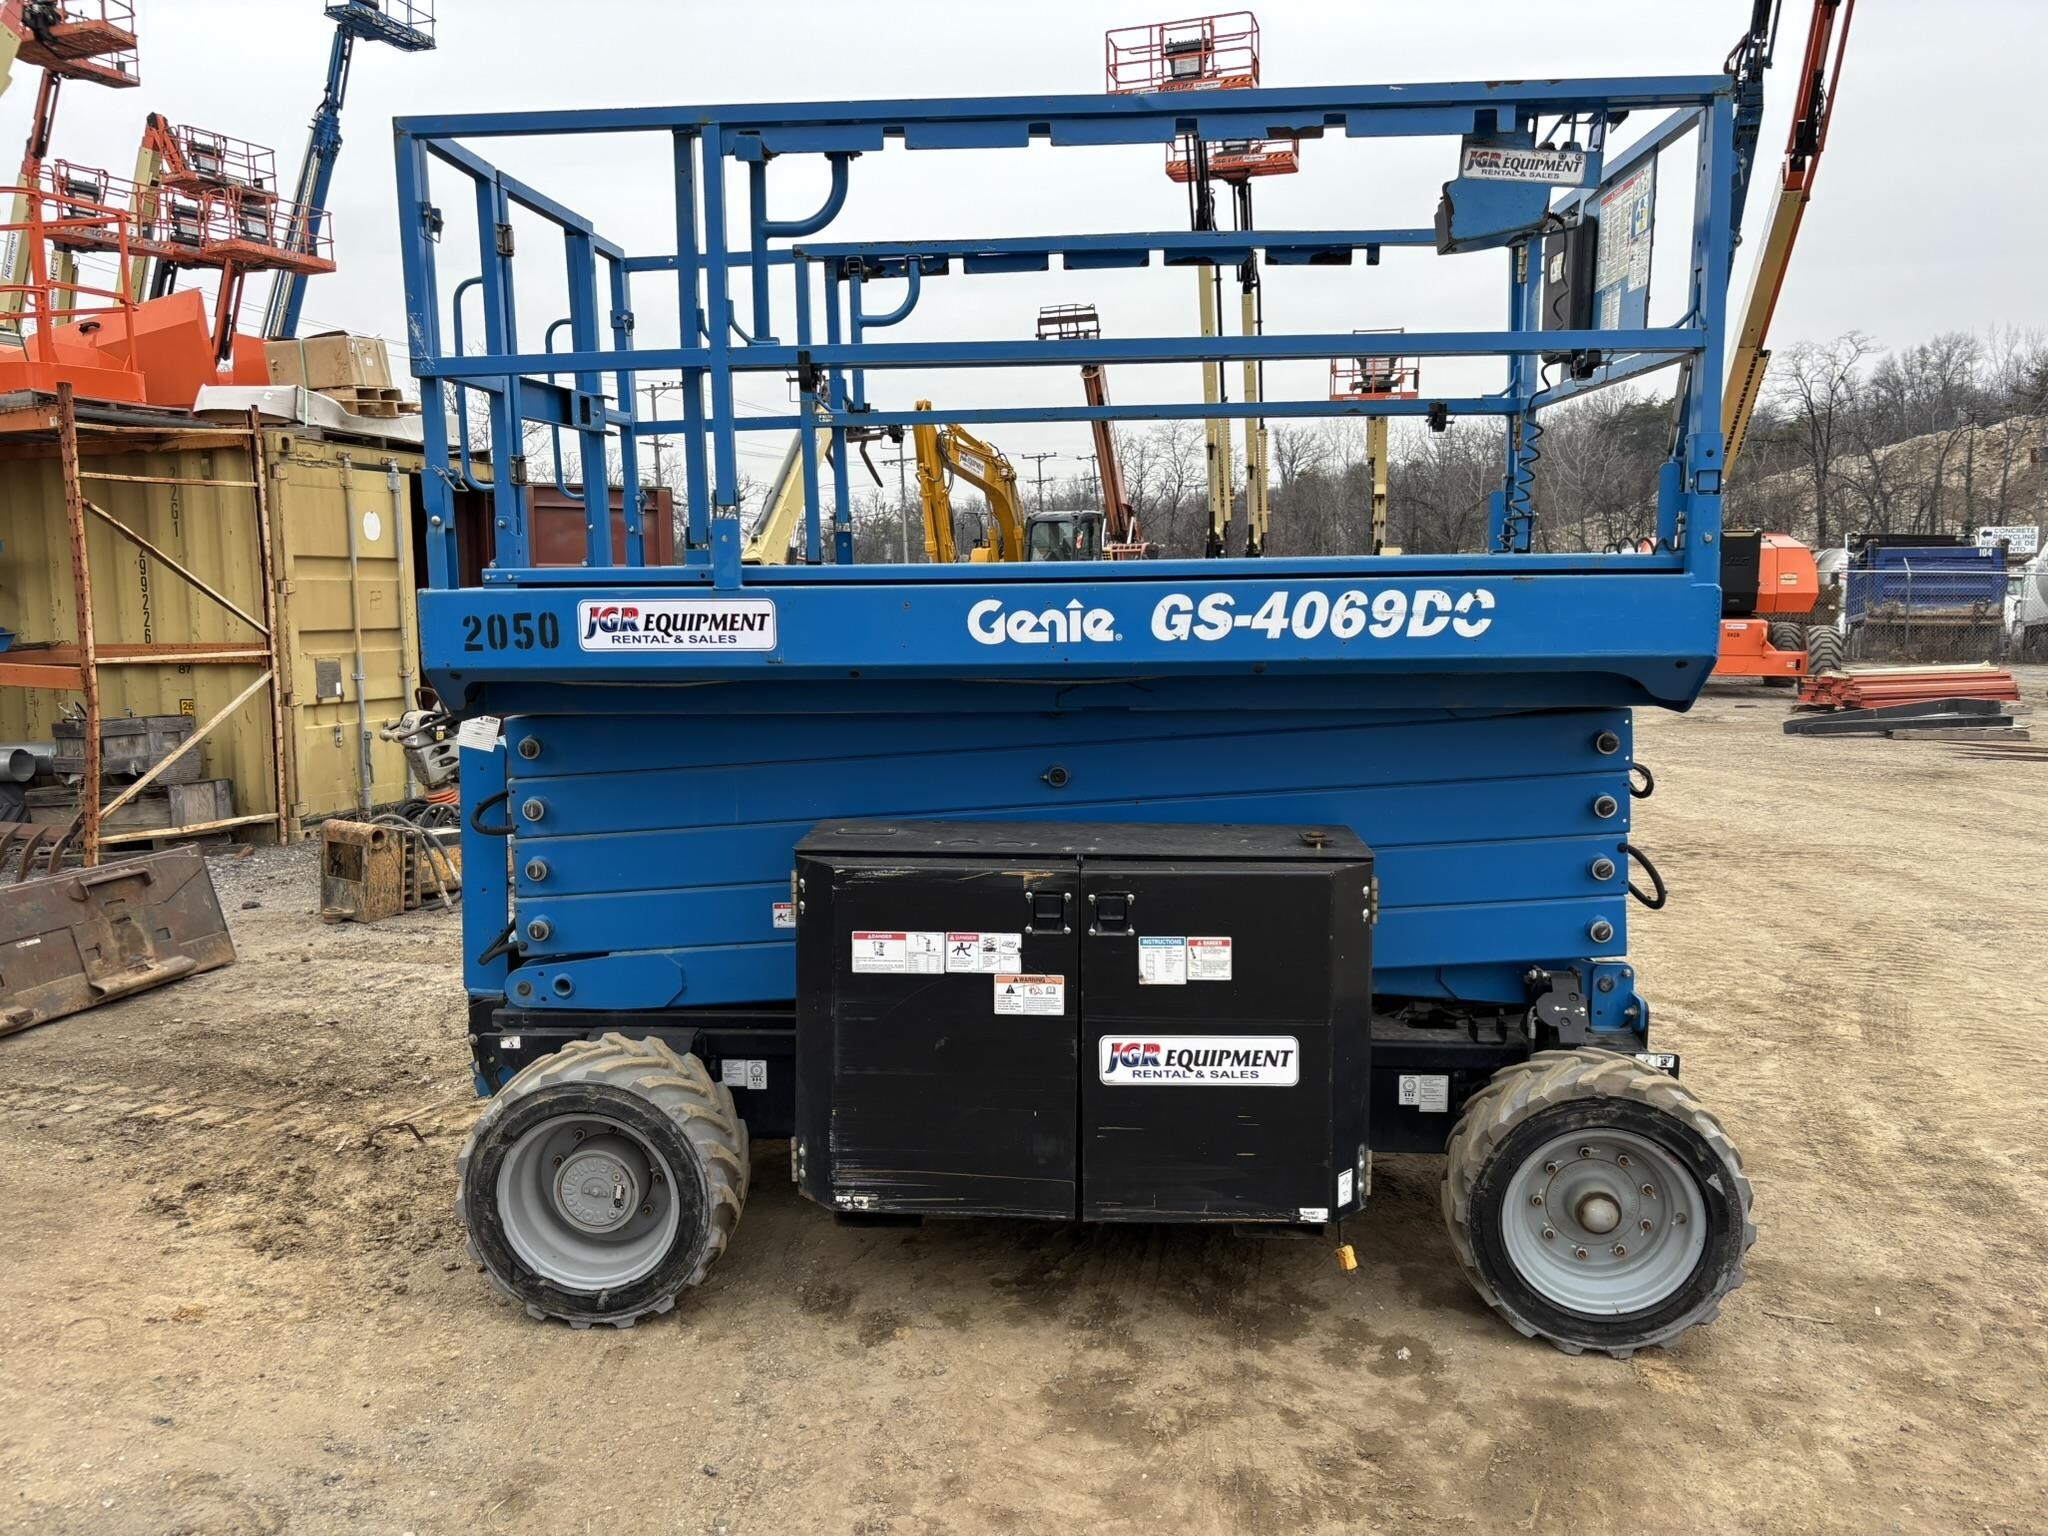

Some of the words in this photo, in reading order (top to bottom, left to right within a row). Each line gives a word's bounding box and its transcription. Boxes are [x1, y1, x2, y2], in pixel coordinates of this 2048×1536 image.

[1465, 150, 1501, 171] JGR
[1503, 156, 1582, 173] EQUIPMENT
[1481, 168, 1516, 177] RENTAL
[1528, 171, 1560, 180] SALES
[1979, 548, 1993, 557] 104
[1151, 589, 1496, 642] GS-4069DC
[584, 606, 640, 640] JGR
[644, 612, 770, 638] EQUIPMENT
[462, 611, 560, 652] 2050
[612, 634, 669, 644] RENTAL
[674, 634, 684, 644] &
[688, 634, 737, 644] SALES
[1142, 938, 1182, 946] INSTRUCTIONS
[1019, 976, 1046, 984] WARNING
[1105, 1042, 1161, 1074] JGR
[1165, 1049, 1294, 1073] EQUIPMENT
[1132, 1069, 1190, 1079] RENTAL
[1195, 1069, 1205, 1079] &
[1210, 1070, 1260, 1079] SALES
